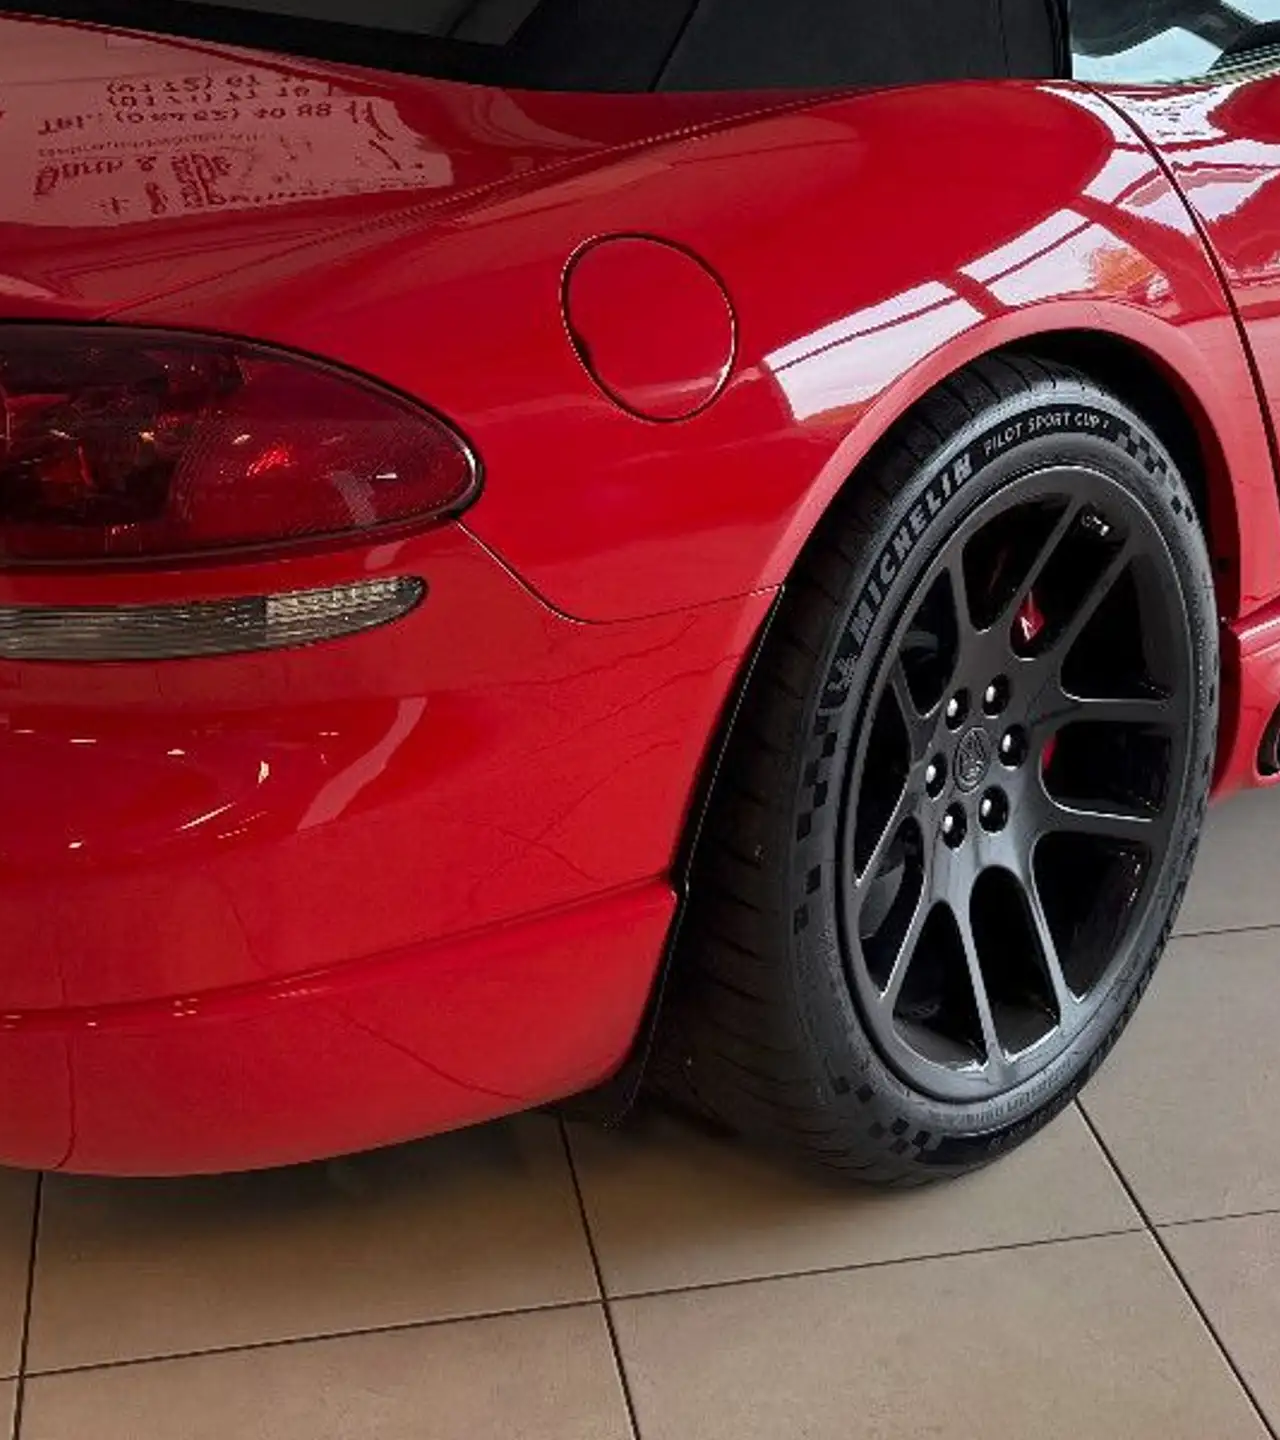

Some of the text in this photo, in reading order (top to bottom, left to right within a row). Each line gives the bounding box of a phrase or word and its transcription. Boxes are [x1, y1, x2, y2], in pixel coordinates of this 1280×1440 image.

[849, 452, 973, 649] MICHELIN
[983, 422, 1024, 457] PILOT
[1027, 412, 1072, 434] SPORT
